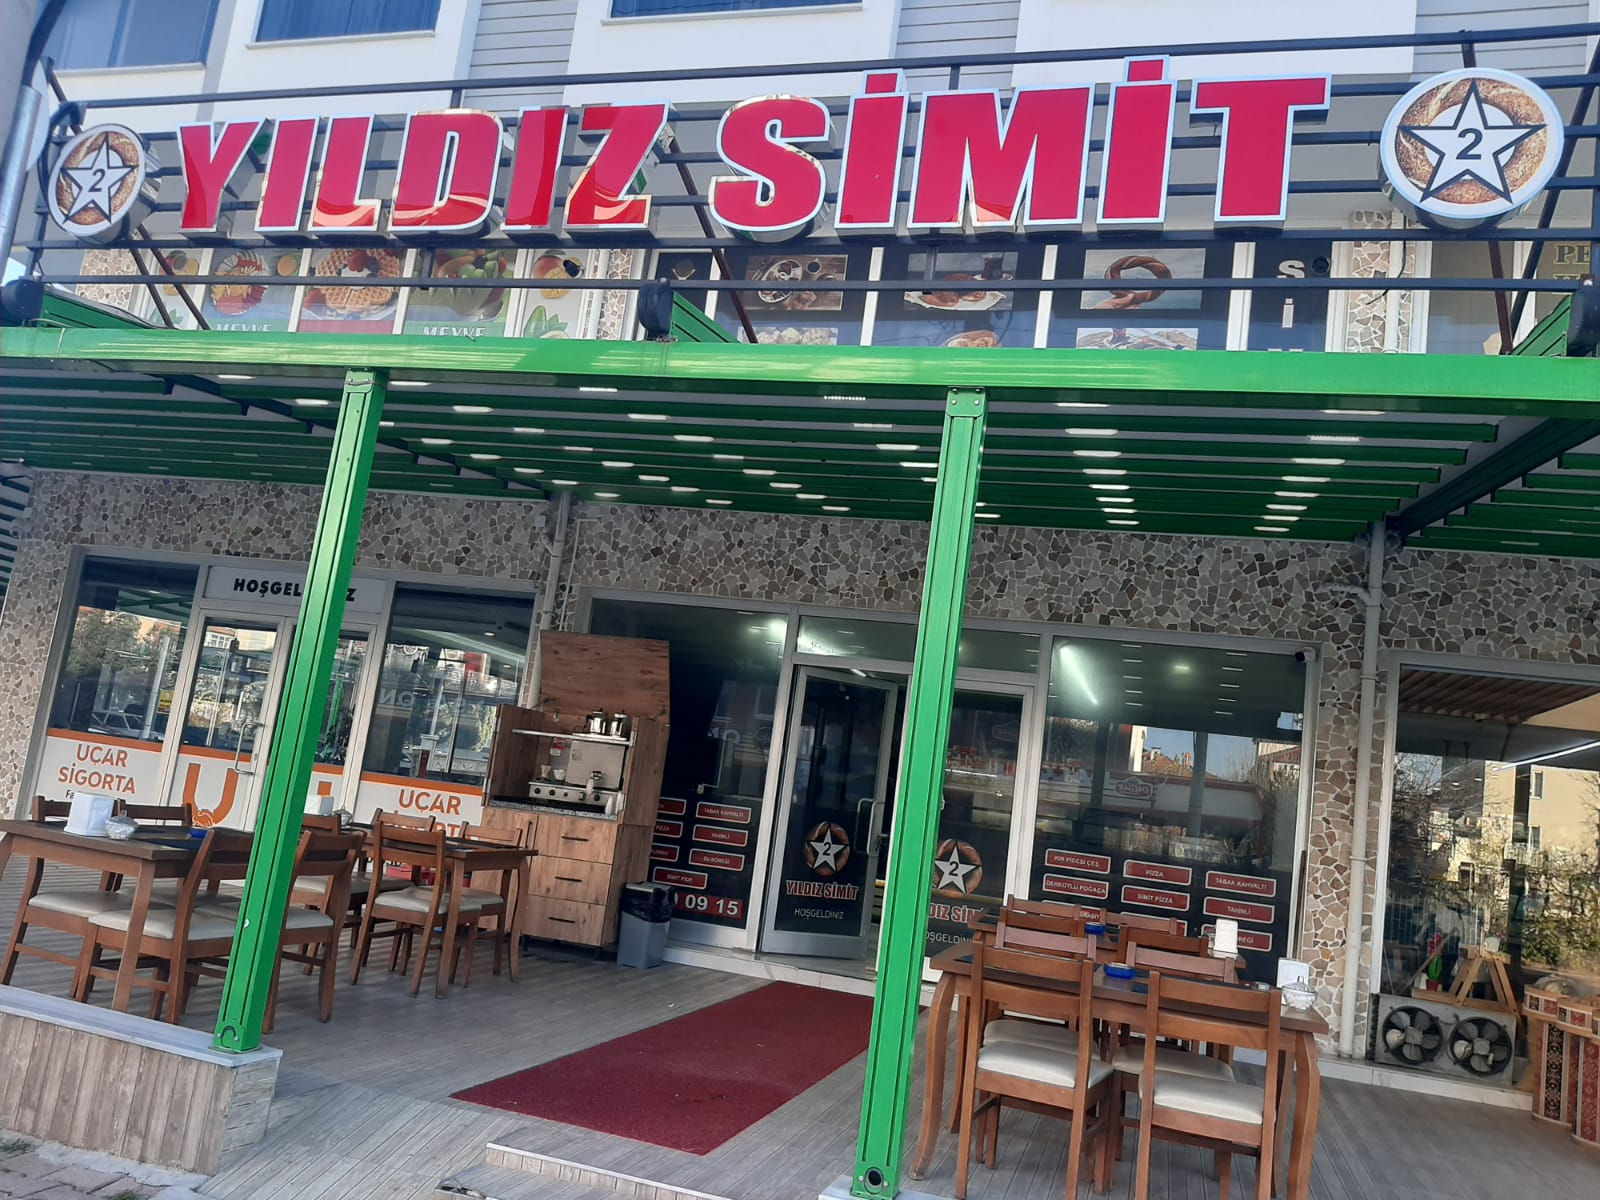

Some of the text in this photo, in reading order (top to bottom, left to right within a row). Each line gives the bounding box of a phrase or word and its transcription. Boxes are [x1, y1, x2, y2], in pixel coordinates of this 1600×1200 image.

[177, 54, 1332, 233] YILDIZ SİMİT
[1456, 127, 1483, 160] 2
[88, 168, 106, 193] 2
[76, 743, 129, 768] UÇAR
[58, 762, 136, 794] SİGORTA
[398, 788, 462, 816] UÇAR
[822, 841, 833, 857] 2
[948, 861, 960, 877] 2
[785, 879, 860, 901] YILDIZ SİMİT
[1215, 877, 1268, 891] TABAK KAHVALTI
[685, 894, 708, 911] 09
[716, 898, 739, 916] 15
[793, 908, 844, 920] HOŞGELDİNİZ
